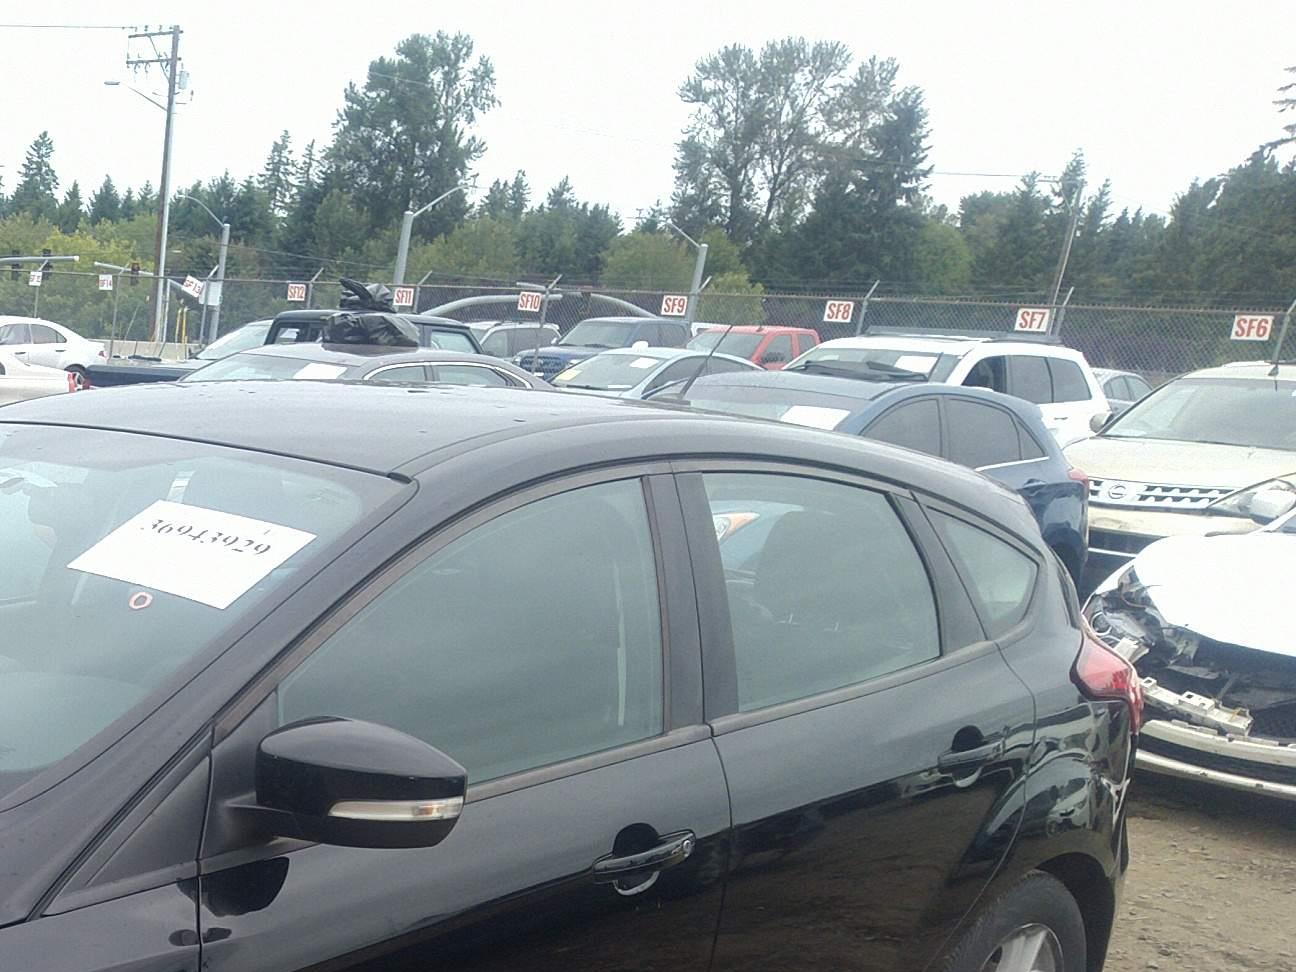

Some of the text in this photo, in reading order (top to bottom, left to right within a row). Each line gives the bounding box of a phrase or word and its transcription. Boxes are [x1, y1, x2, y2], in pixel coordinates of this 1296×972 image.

[288, 285, 304, 299] SF12
[395, 289, 412, 304] SF11
[519, 292, 540, 310] SF10
[663, 296, 686, 314] SF9
[827, 302, 852, 320] SF8
[1018, 309, 1047, 329] SF7
[1234, 318, 1270, 338] SF6
